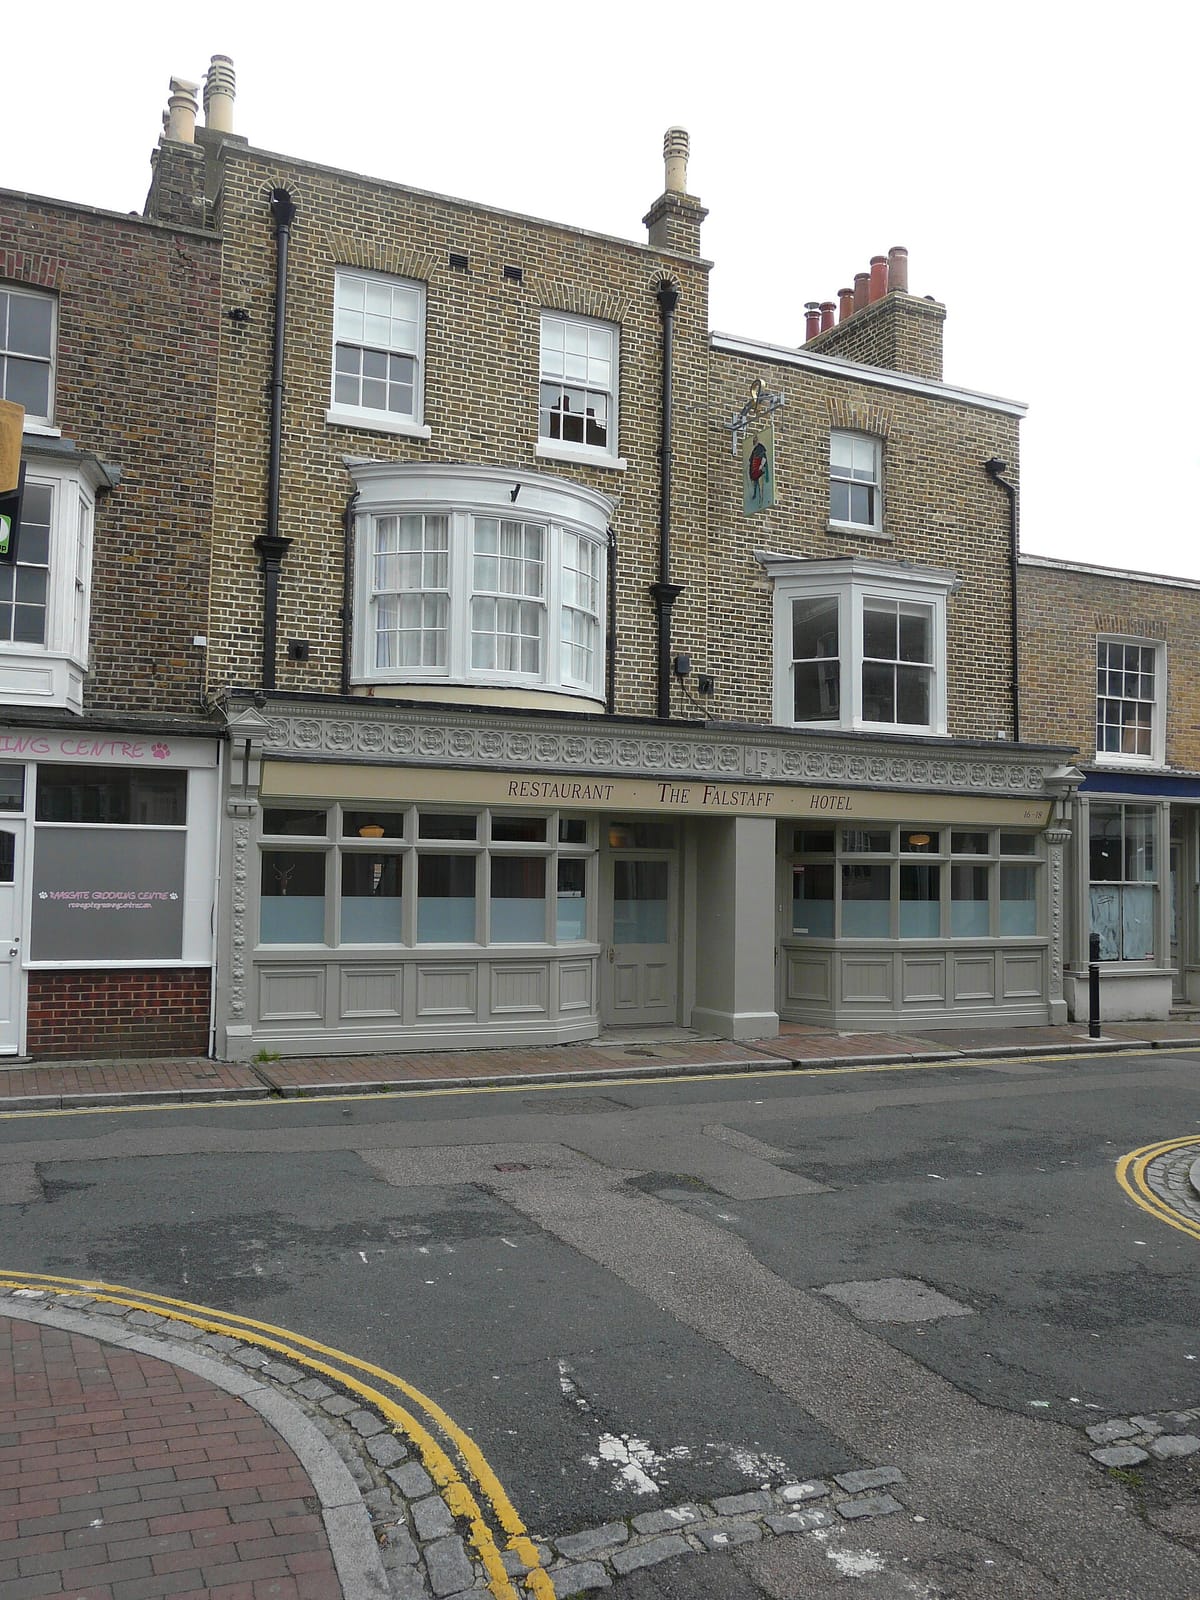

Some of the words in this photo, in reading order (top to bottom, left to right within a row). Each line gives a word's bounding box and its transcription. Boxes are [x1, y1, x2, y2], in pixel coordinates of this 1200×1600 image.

[60, 738, 147, 759] CENTRE
[508, 780, 614, 801] RESTAURANT
[810, 794, 853, 811] HOTEL
